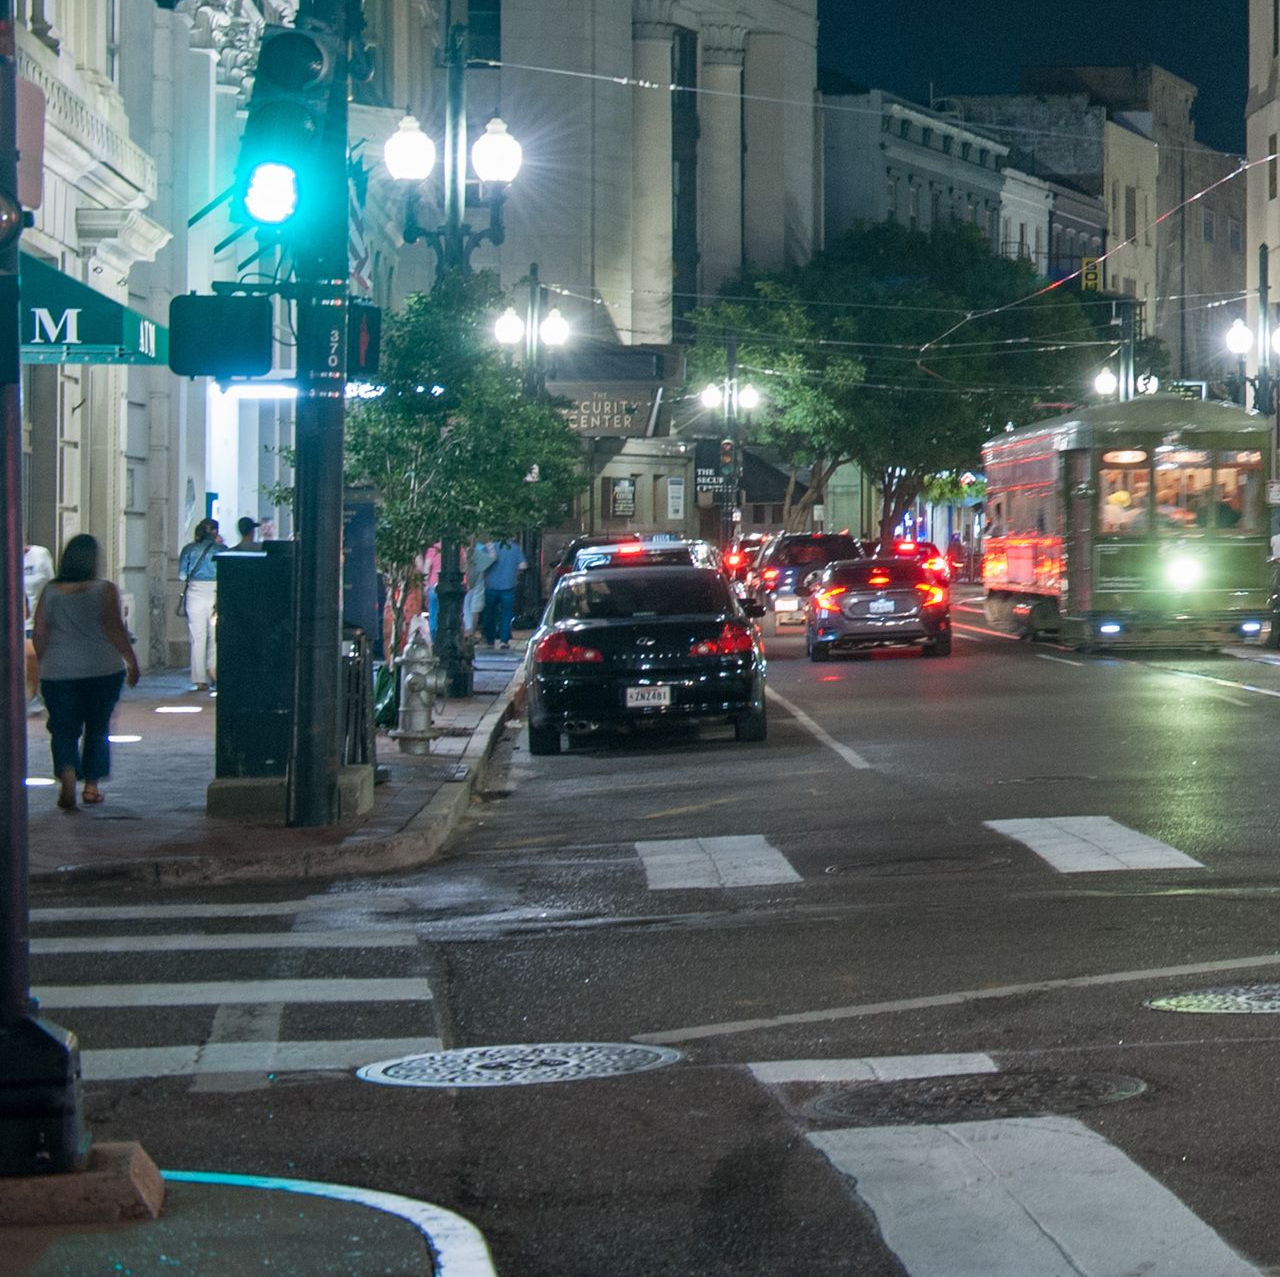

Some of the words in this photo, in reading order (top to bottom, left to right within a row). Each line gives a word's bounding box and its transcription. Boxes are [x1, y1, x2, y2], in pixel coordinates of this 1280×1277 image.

[327, 329, 340, 367] 370
[593, 391, 608, 399] THE
[568, 415, 632, 429] CENTER
